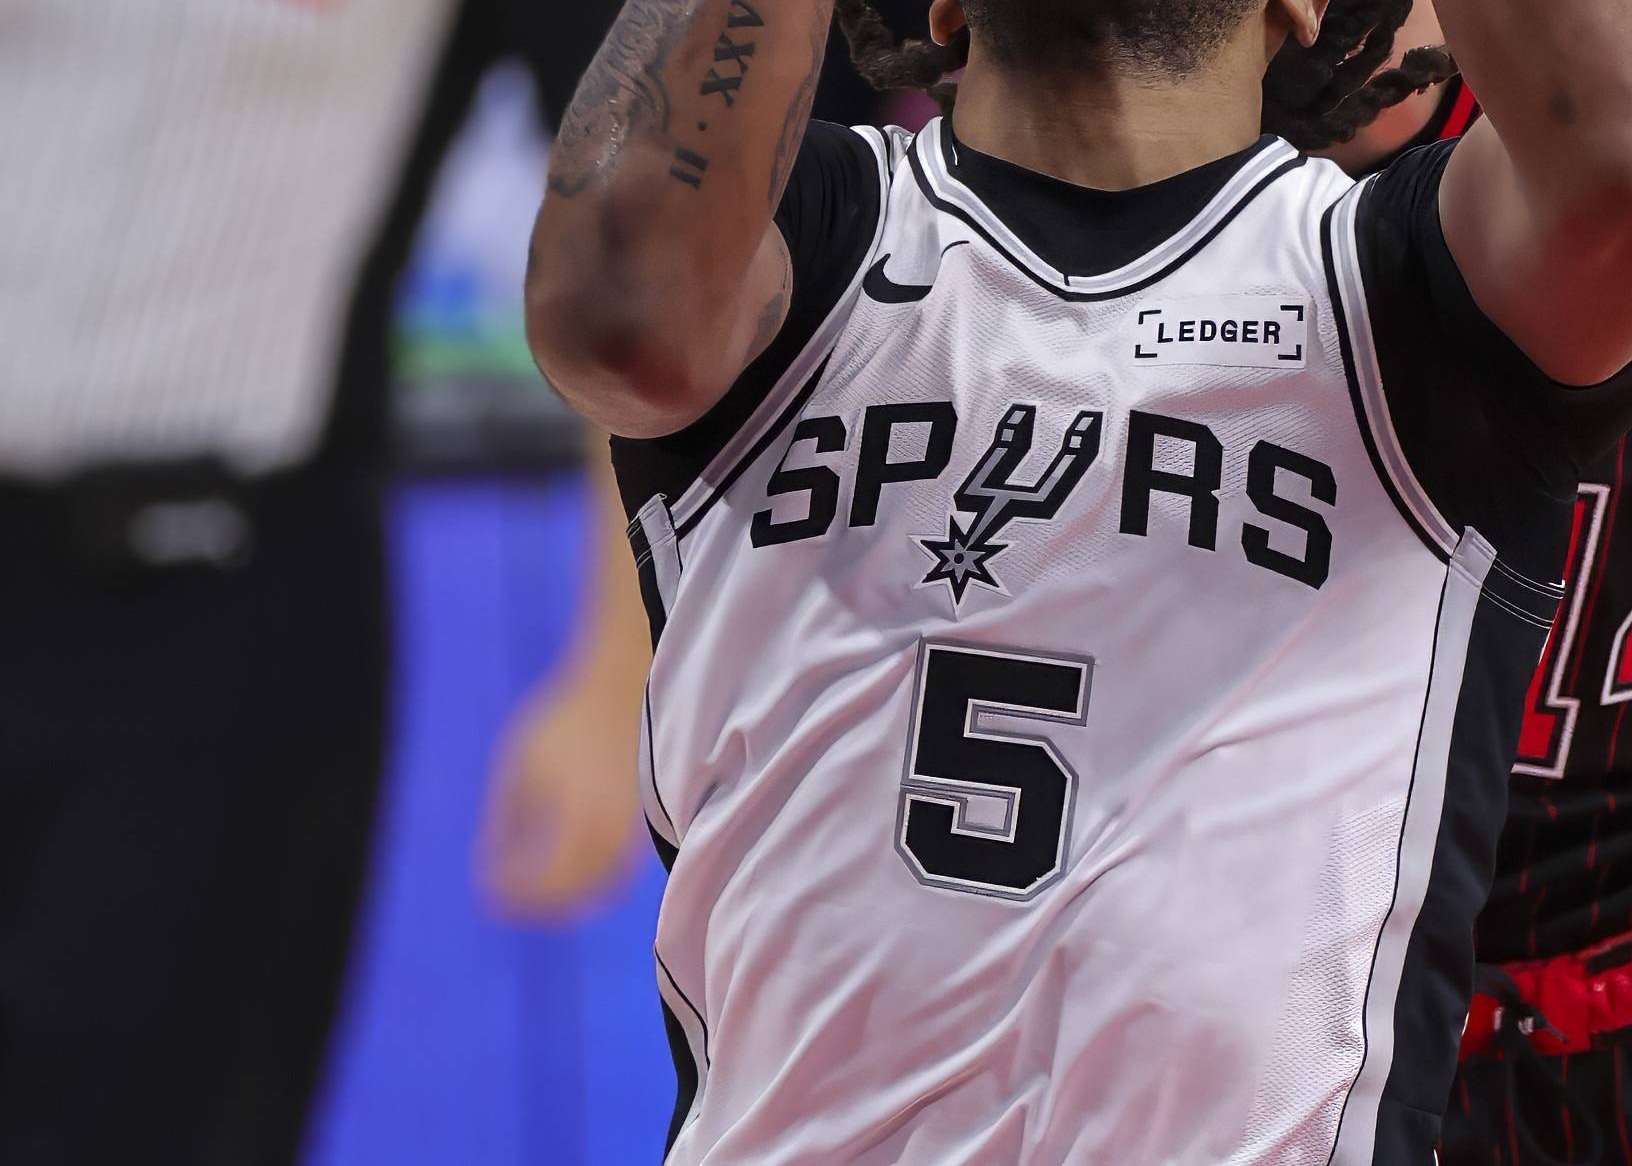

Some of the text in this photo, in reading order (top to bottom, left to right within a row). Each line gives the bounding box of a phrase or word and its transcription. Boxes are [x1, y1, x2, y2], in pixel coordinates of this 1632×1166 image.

[669, 147, 710, 190] II
[1157, 319, 1281, 345] LEDGER
[749, 400, 1338, 604] SPURS
[893, 634, 1097, 902] 5
